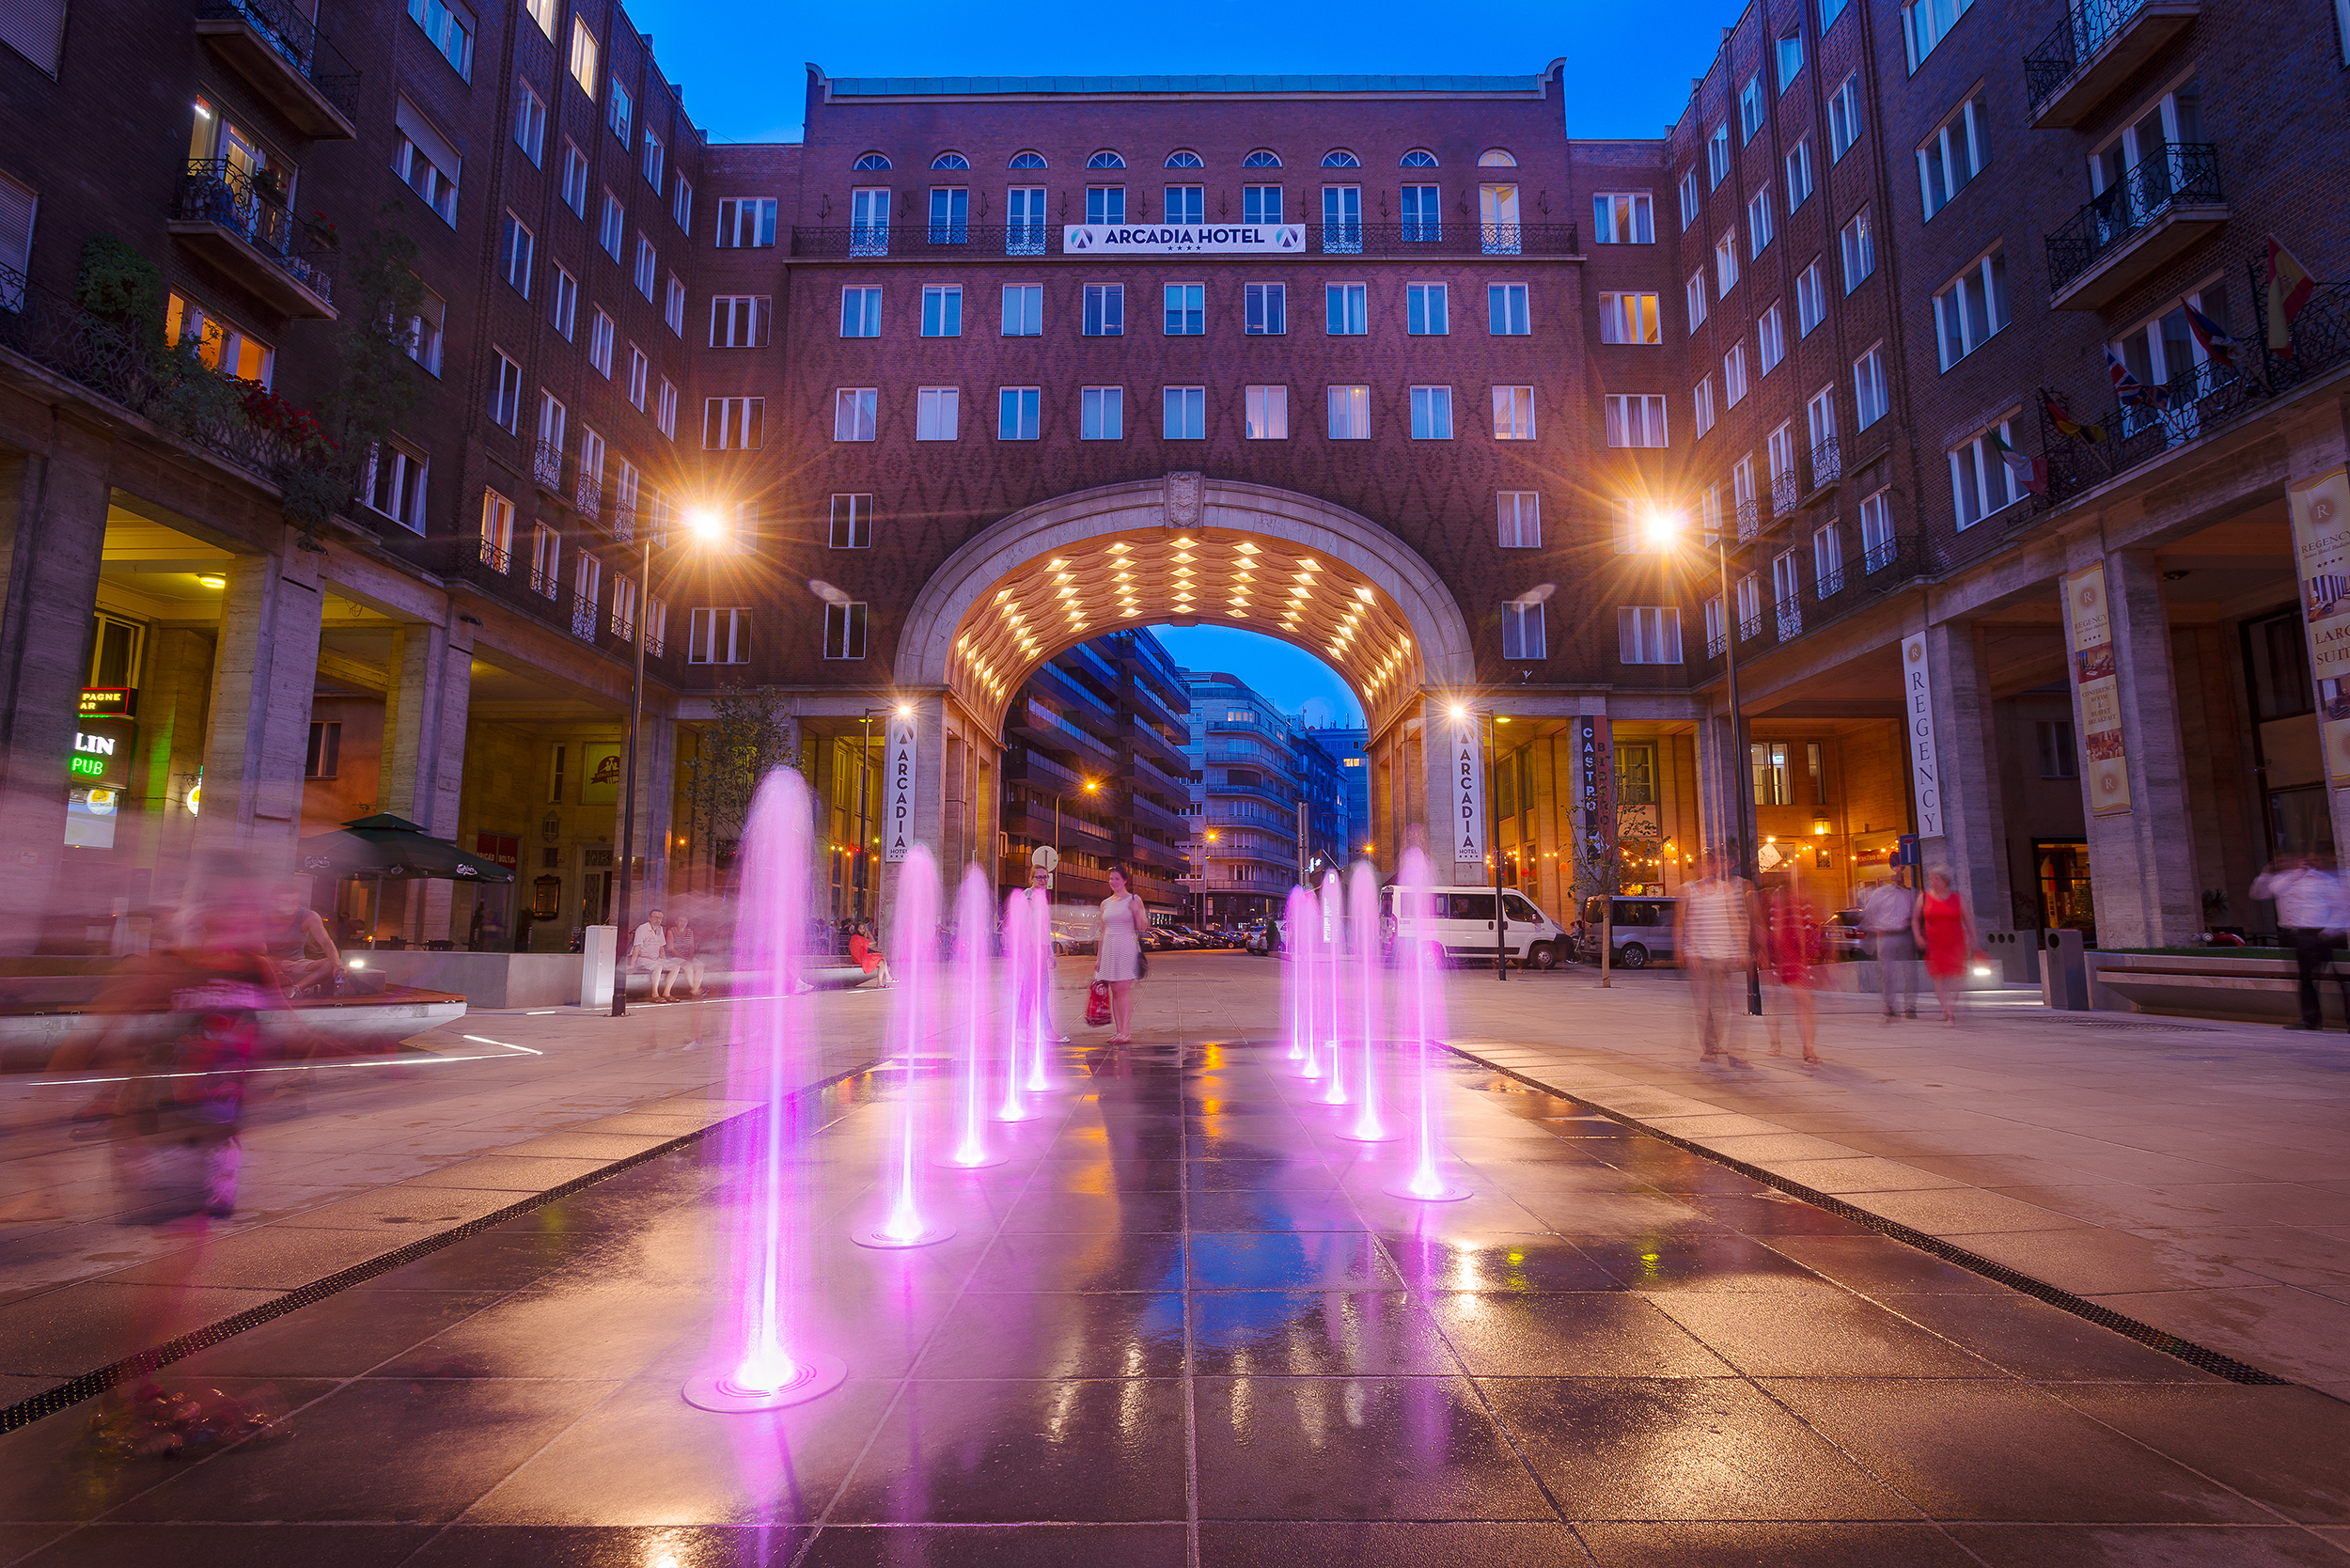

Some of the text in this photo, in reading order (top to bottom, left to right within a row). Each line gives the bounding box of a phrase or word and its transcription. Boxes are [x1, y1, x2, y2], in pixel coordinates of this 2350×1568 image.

[1104, 228, 1265, 243] ARCADIA HOTEL
[2317, 504, 2330, 519] R
[2083, 591, 2092, 603] R
[2074, 613, 2107, 630] REGENCY
[1911, 648, 1919, 658] R
[1911, 670, 1935, 833] REGENCY
[71, 757, 103, 776] PUB
[1582, 727, 1597, 811] CASTRO
[2105, 777, 2114, 789] R
[894, 748, 909, 848] ARCADIA
[1459, 748, 1475, 848] ARCADIA
